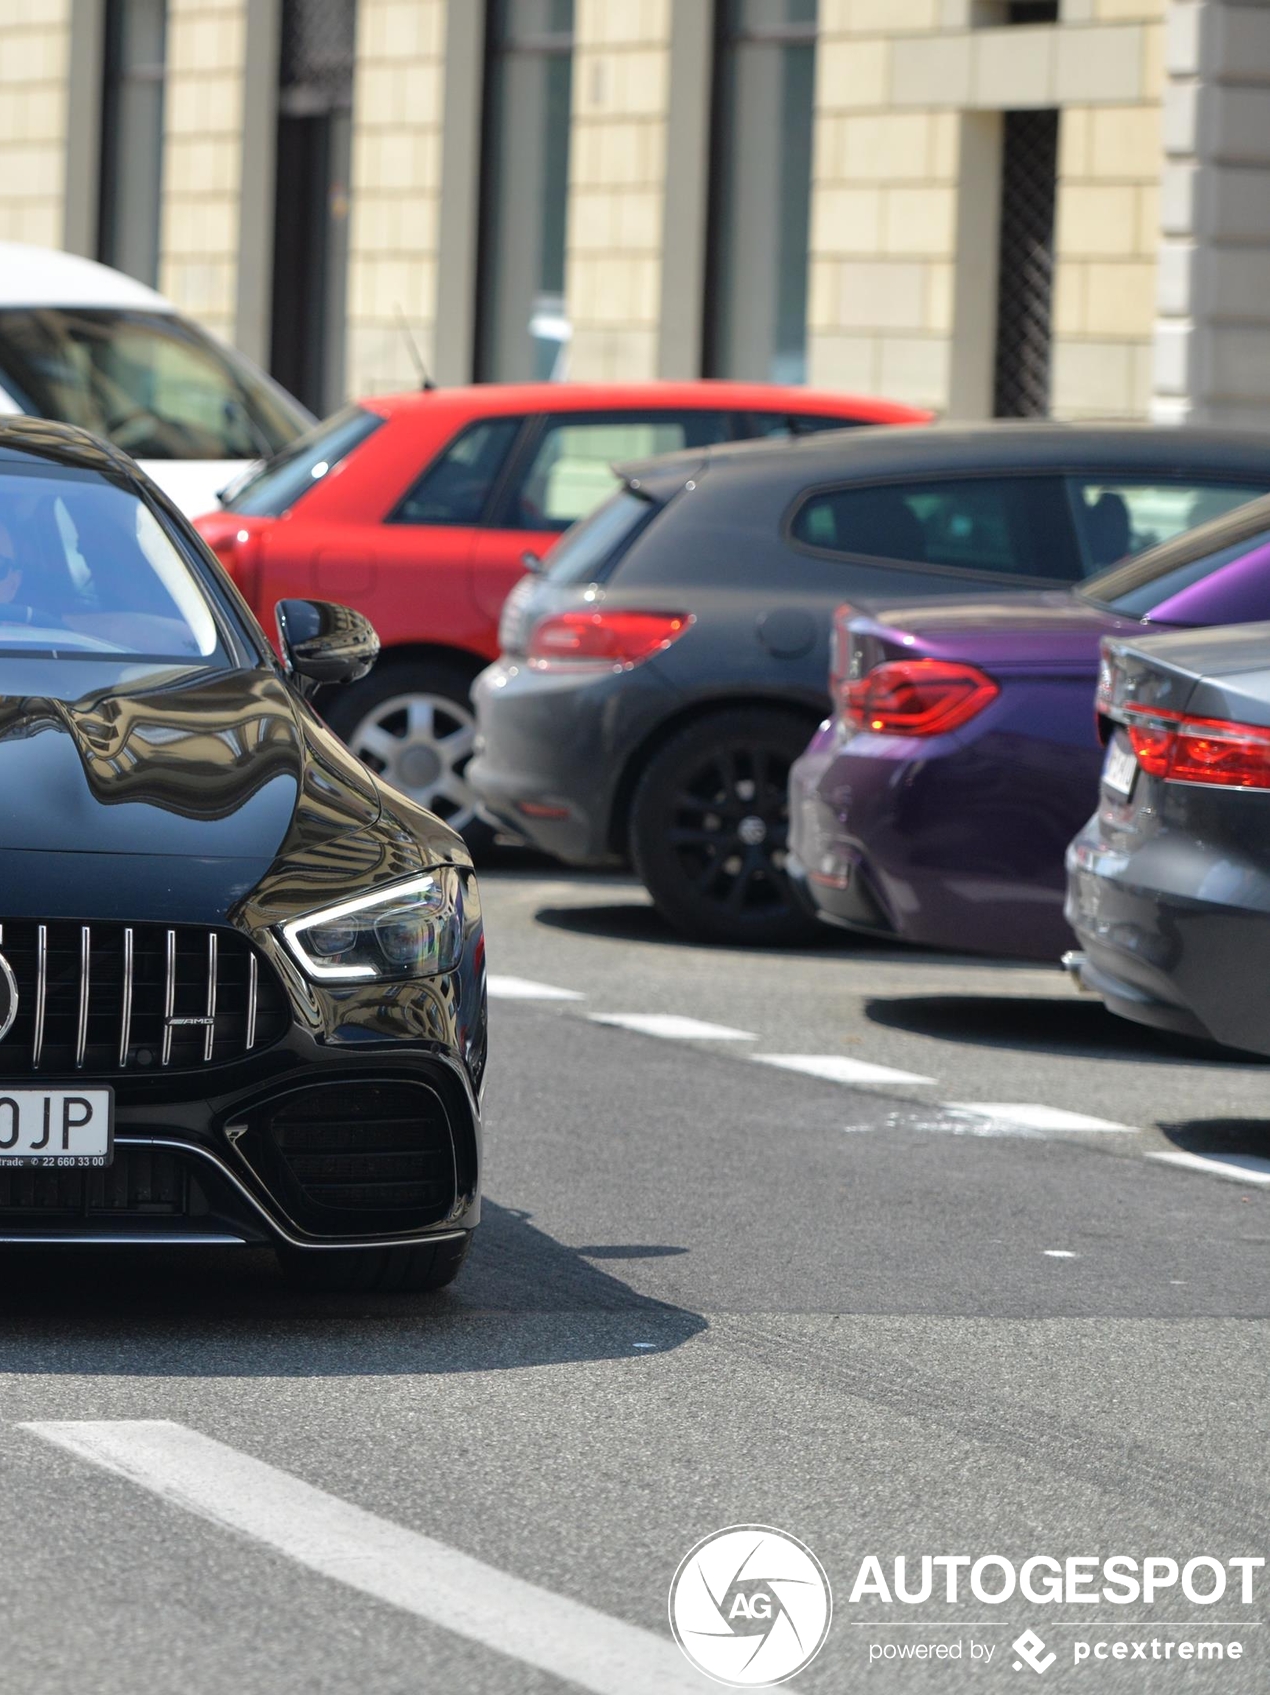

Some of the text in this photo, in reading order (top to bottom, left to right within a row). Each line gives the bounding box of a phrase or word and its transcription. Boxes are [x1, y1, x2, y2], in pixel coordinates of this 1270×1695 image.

[42, 1157, 55, 1167] 22
[57, 1157, 76, 1167] 660
[77, 1157, 90, 1167] 33
[92, 1157, 104, 1167] 00
